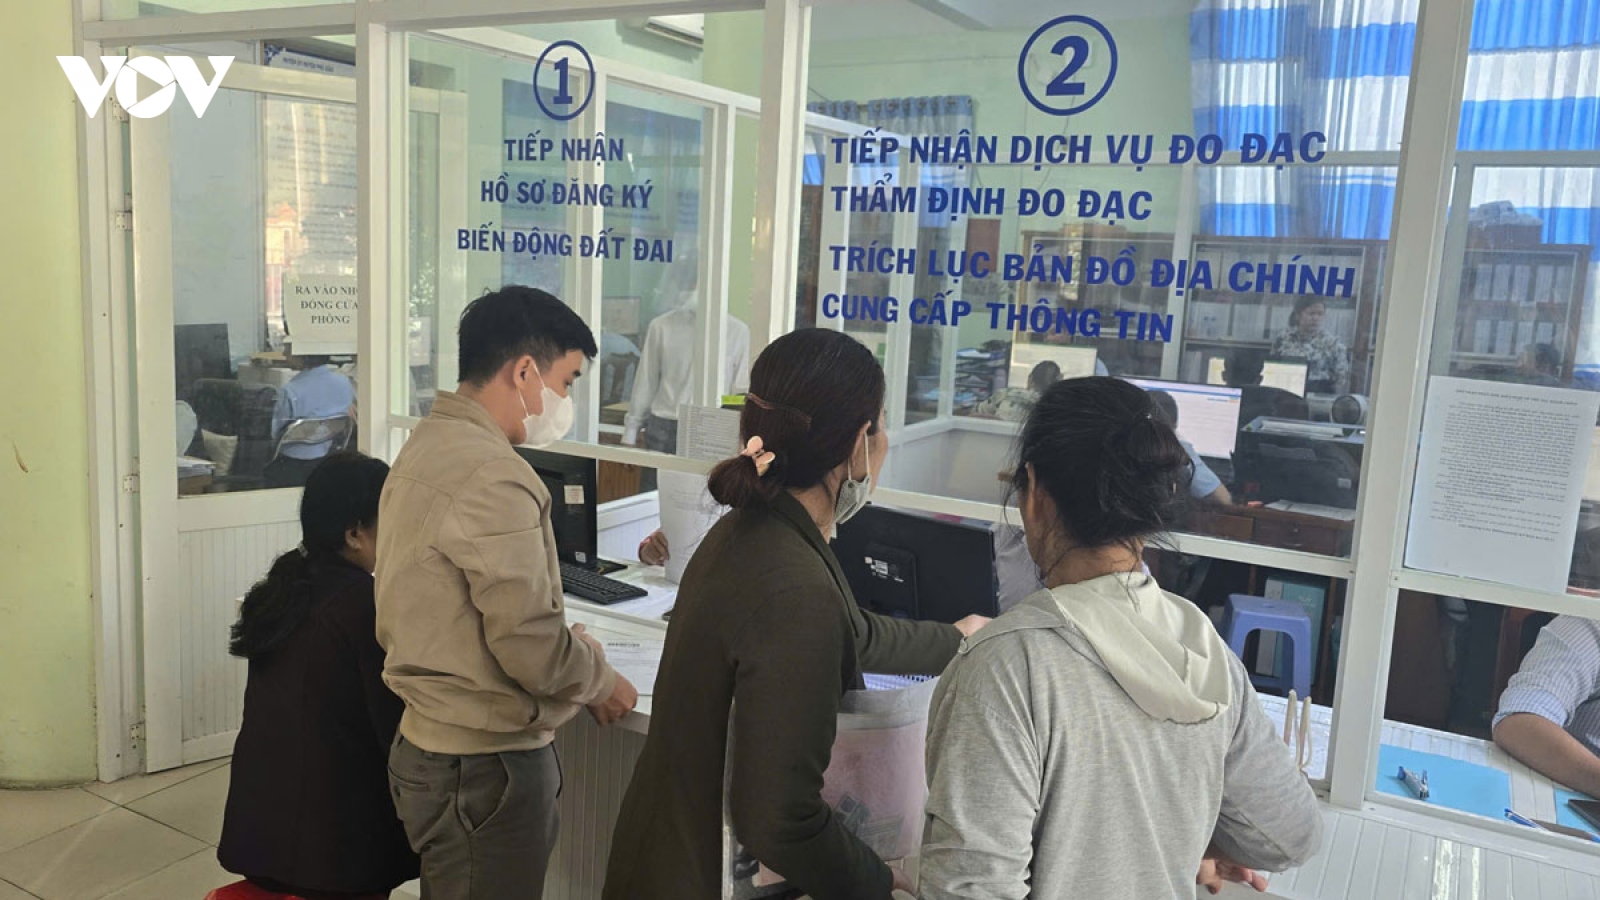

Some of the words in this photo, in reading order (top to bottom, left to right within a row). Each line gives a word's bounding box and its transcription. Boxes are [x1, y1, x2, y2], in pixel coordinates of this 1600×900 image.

[552, 57, 573, 105] 1
[1044, 34, 1090, 97] 2
[504, 130, 553, 161] TIẾP
[561, 131, 625, 166] NHẬN
[831, 127, 899, 164] TIẾP
[910, 129, 998, 166] NHẬN
[1009, 135, 1092, 171] DỊCH
[1106, 134, 1155, 172] VỤ
[1169, 133, 1223, 164] ĐO
[1240, 130, 1328, 169] ĐẠC
[480, 172, 509, 203] HỒ
[516, 179, 546, 205] SƠ
[552, 178, 614, 207] ĐĂNG
[622, 179, 654, 209] KÝ
[831, 172, 916, 213] THẨM
[927, 187, 1005, 221] ĐỊNH
[1017, 188, 1065, 217] ĐO
[1077, 189, 1153, 226] ĐẠC
[457, 222, 505, 253] BIẾN
[512, 226, 572, 260] ĐỘNG
[579, 228, 625, 259] ĐẤT
[634, 239, 673, 263] ĐAI
[295, 285, 310, 295] RA
[340, 286, 358, 295] NH
[829, 241, 916, 275] TRÍCH
[928, 249, 990, 285] LỤC
[1002, 243, 1073, 285] BẢN
[1085, 245, 1137, 287] ĐỒ
[1151, 257, 1213, 301] ĐỊA
[1228, 254, 1356, 299] CHÍNH
[822, 292, 898, 324] CUNG
[909, 292, 972, 327] CẤP
[986, 300, 1101, 339] THÔNG
[1118, 309, 1174, 343] TIN
